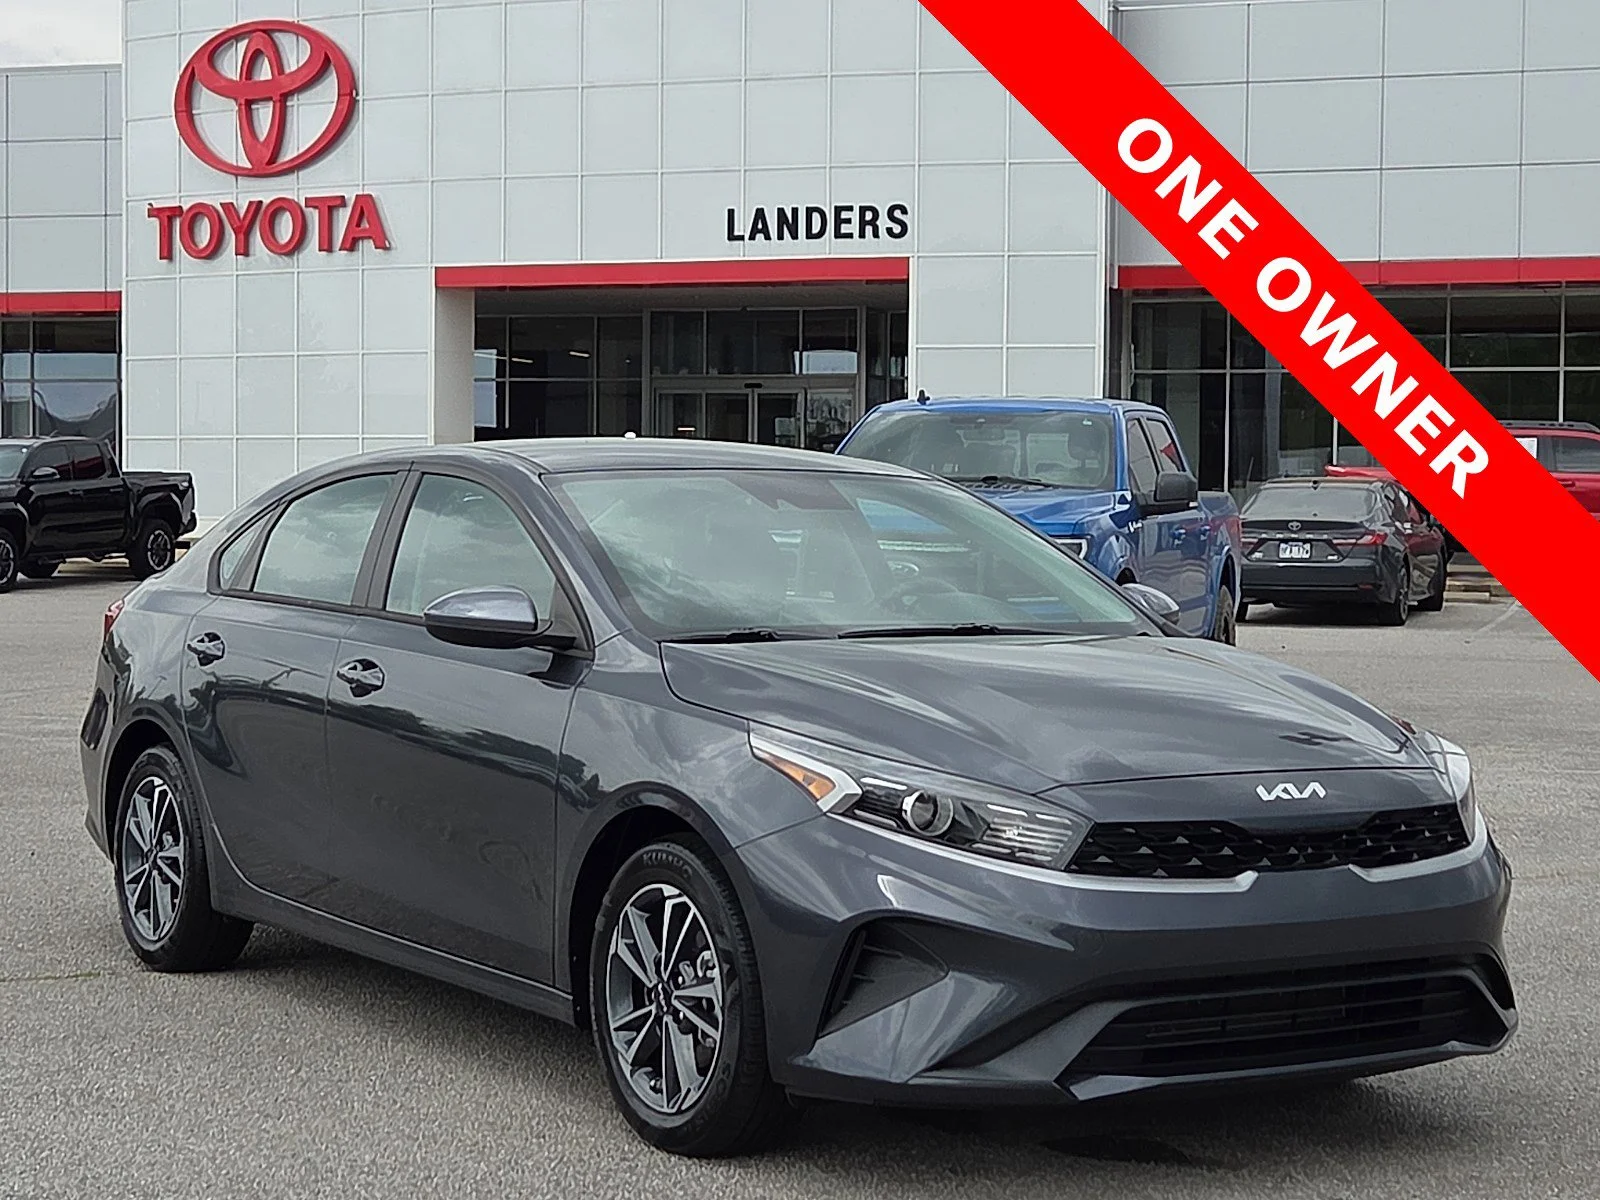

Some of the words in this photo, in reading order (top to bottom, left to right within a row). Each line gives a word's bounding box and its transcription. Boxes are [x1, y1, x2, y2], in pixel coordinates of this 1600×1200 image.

[148, 194, 391, 260] TOYOTA
[727, 204, 909, 241] LANDERS
[1255, 782, 1327, 801] KIA
